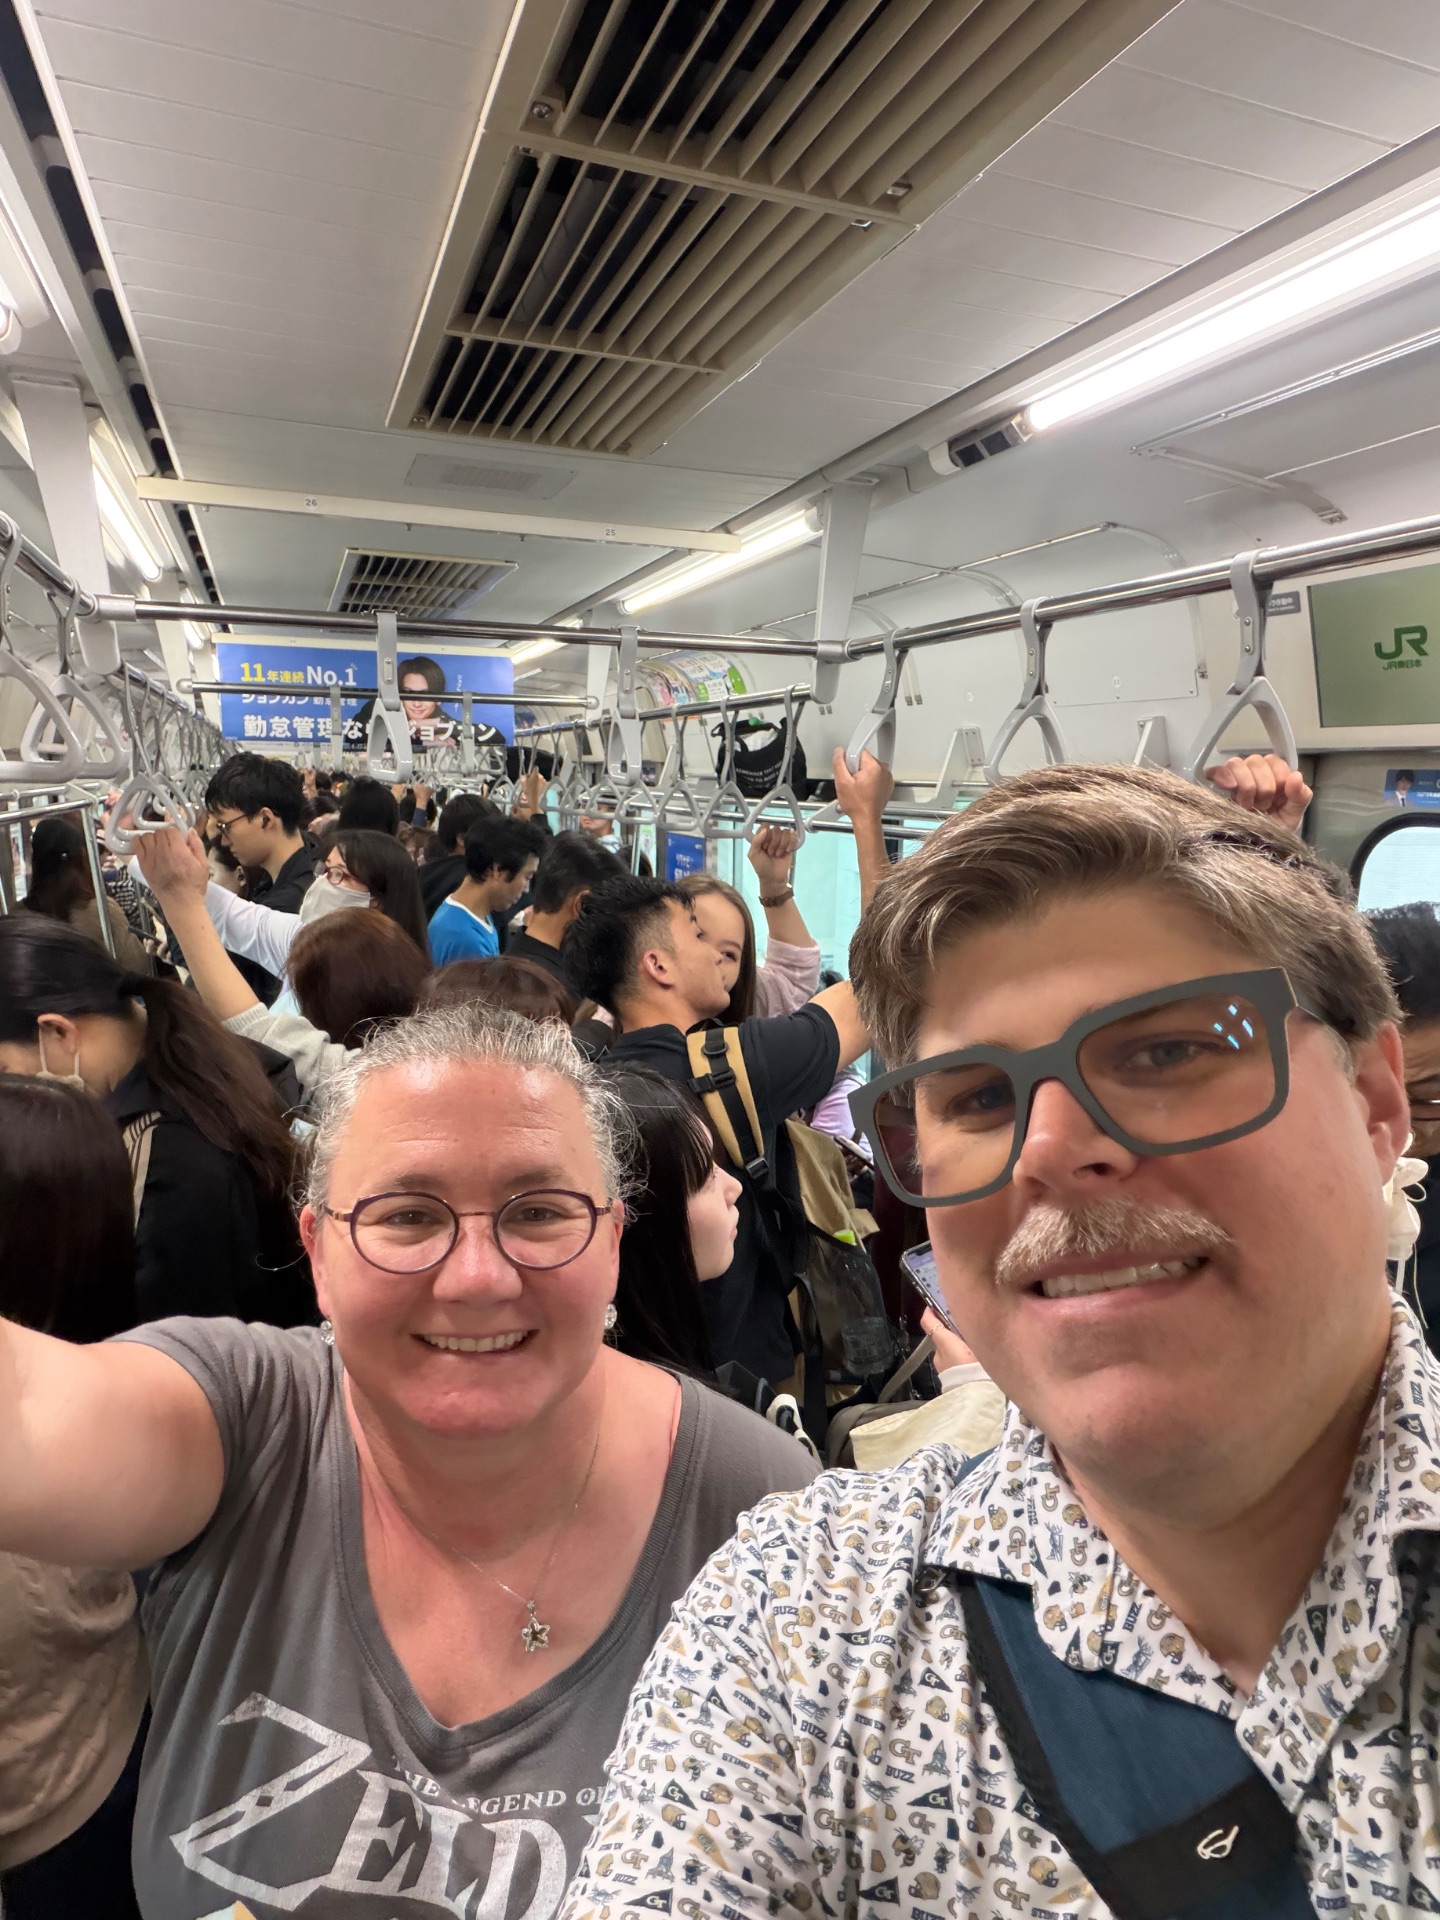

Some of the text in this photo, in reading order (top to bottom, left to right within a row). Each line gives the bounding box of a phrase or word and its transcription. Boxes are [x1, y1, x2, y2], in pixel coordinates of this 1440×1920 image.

[305, 498, 318, 507] 26
[1374, 625, 1429, 660] JR
[168, 1691, 602, 1920] ZELD
